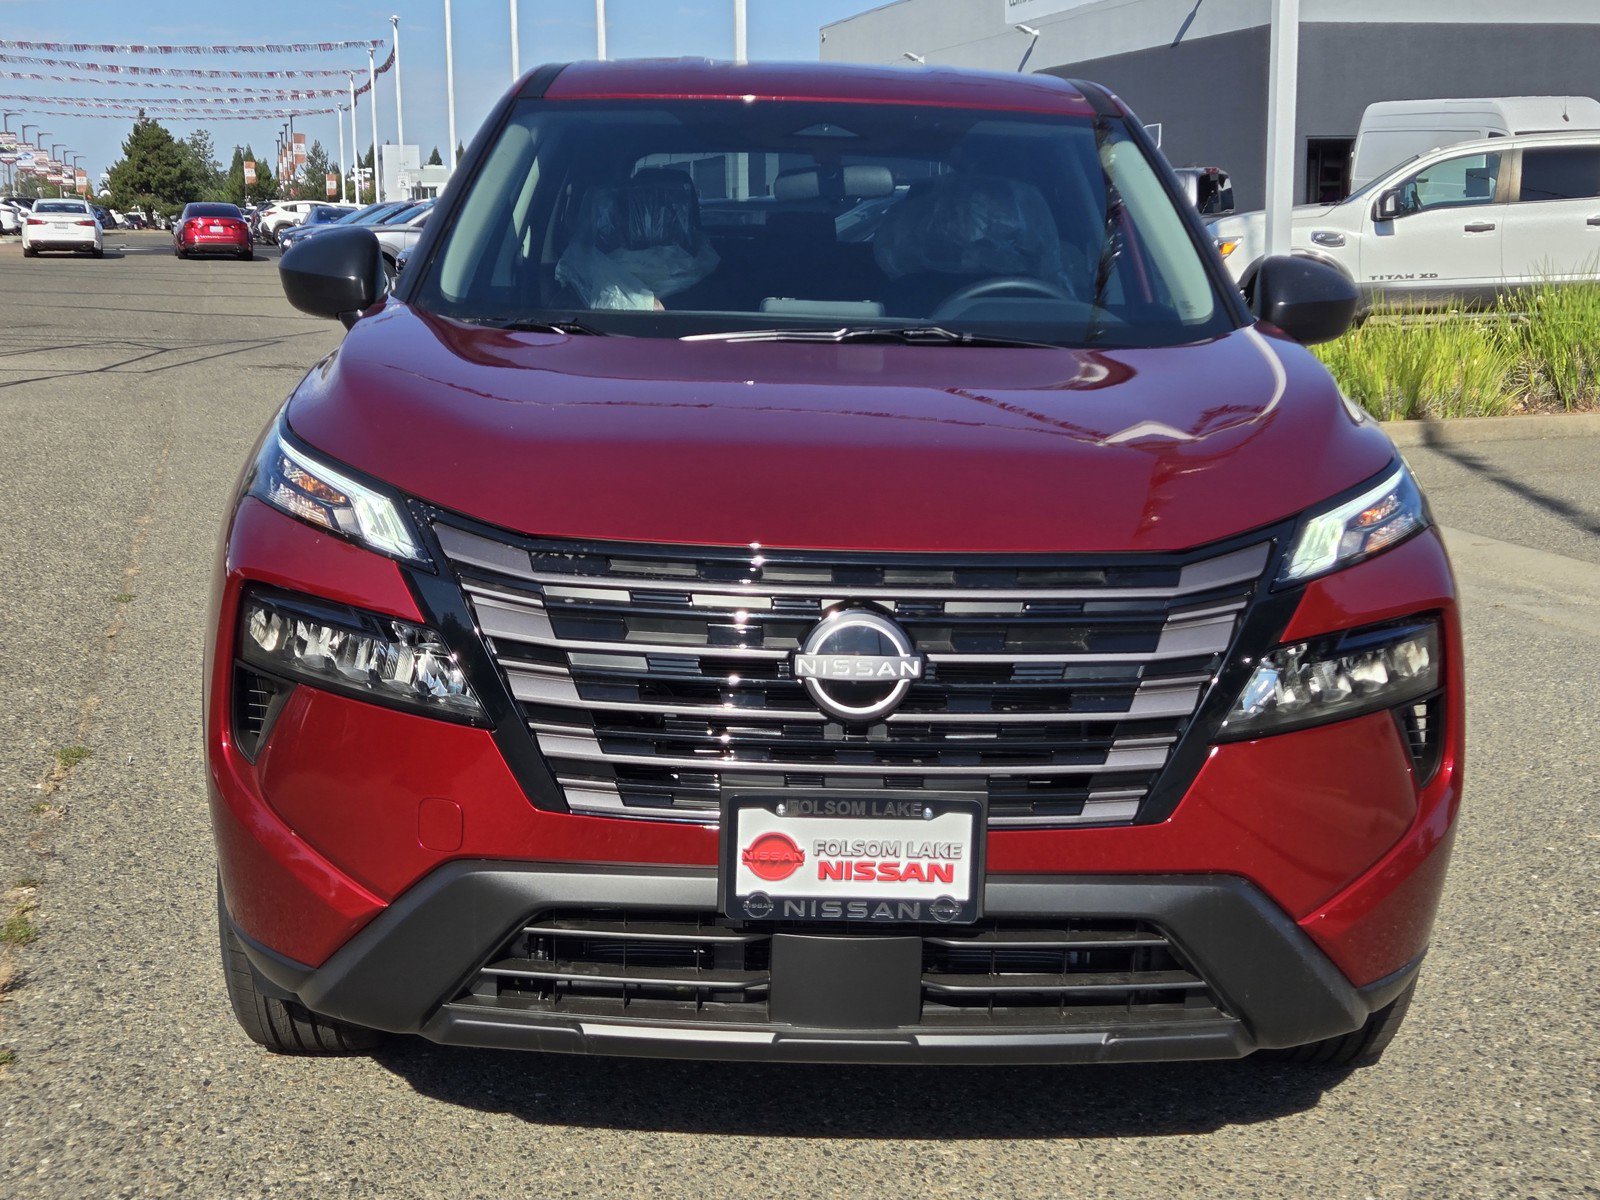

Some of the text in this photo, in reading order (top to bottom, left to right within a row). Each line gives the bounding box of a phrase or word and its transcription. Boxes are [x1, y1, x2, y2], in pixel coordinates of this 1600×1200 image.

[1369, 273, 1414, 281] TITAN
[797, 658, 920, 677] NISSAN
[872, 802, 922, 817] LAKE
[742, 850, 805, 862] NISSAN
[813, 839, 963, 860] FOLSOM LAKE
[818, 860, 954, 883] NISSAN
[784, 899, 920, 920] NISSAN
